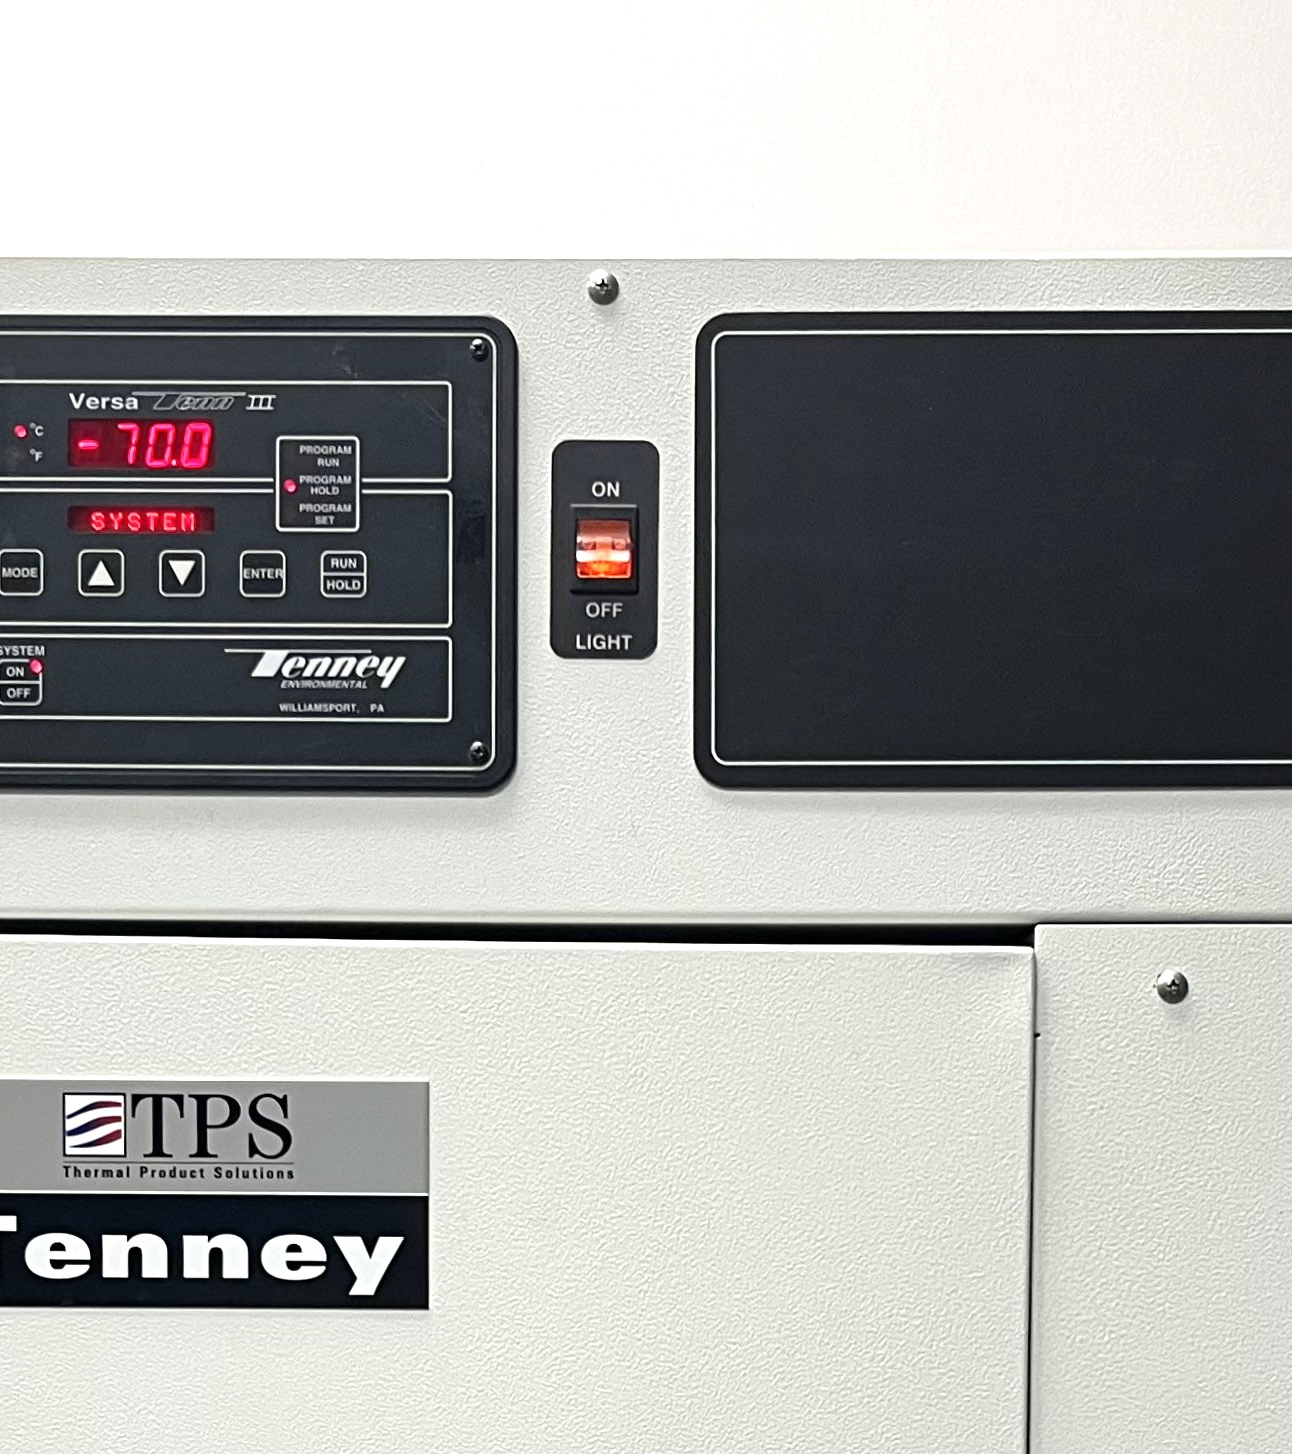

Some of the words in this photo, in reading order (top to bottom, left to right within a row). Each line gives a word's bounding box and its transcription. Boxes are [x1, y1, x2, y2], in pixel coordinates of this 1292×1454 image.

[68, 392, 139, 410] Versa
[132, 391, 246, 411] Tenn
[245, 394, 277, 411] III
[299, 445, 352, 455] PROGRAM
[317, 458, 340, 467] RUN
[299, 475, 352, 485] PROGRAM
[310, 486, 340, 496] HOLD
[591, 481, 620, 497] ON
[299, 503, 352, 513] PROGRAM
[91, 511, 196, 532] SYSTEM
[314, 515, 335, 525] SET
[330, 557, 357, 569] RUN
[1, 567, 39, 579] MODE
[243, 568, 285, 579] ENTER
[326, 579, 361, 591] HOLD
[585, 602, 623, 618] OFF
[575, 634, 633, 650] LIGHT
[6, 666, 25, 678] ON
[224, 649, 407, 688] Tenney
[280, 679, 368, 689] ENVIRONMENTAL
[6, 687, 31, 699] OFF
[370, 703, 385, 713] PA
[131, 1093, 293, 1159] TPS
[63, 1165, 131, 1179] Thermal
[139, 1166, 205, 1179] Product
[213, 1167, 295, 1180] Solutions
